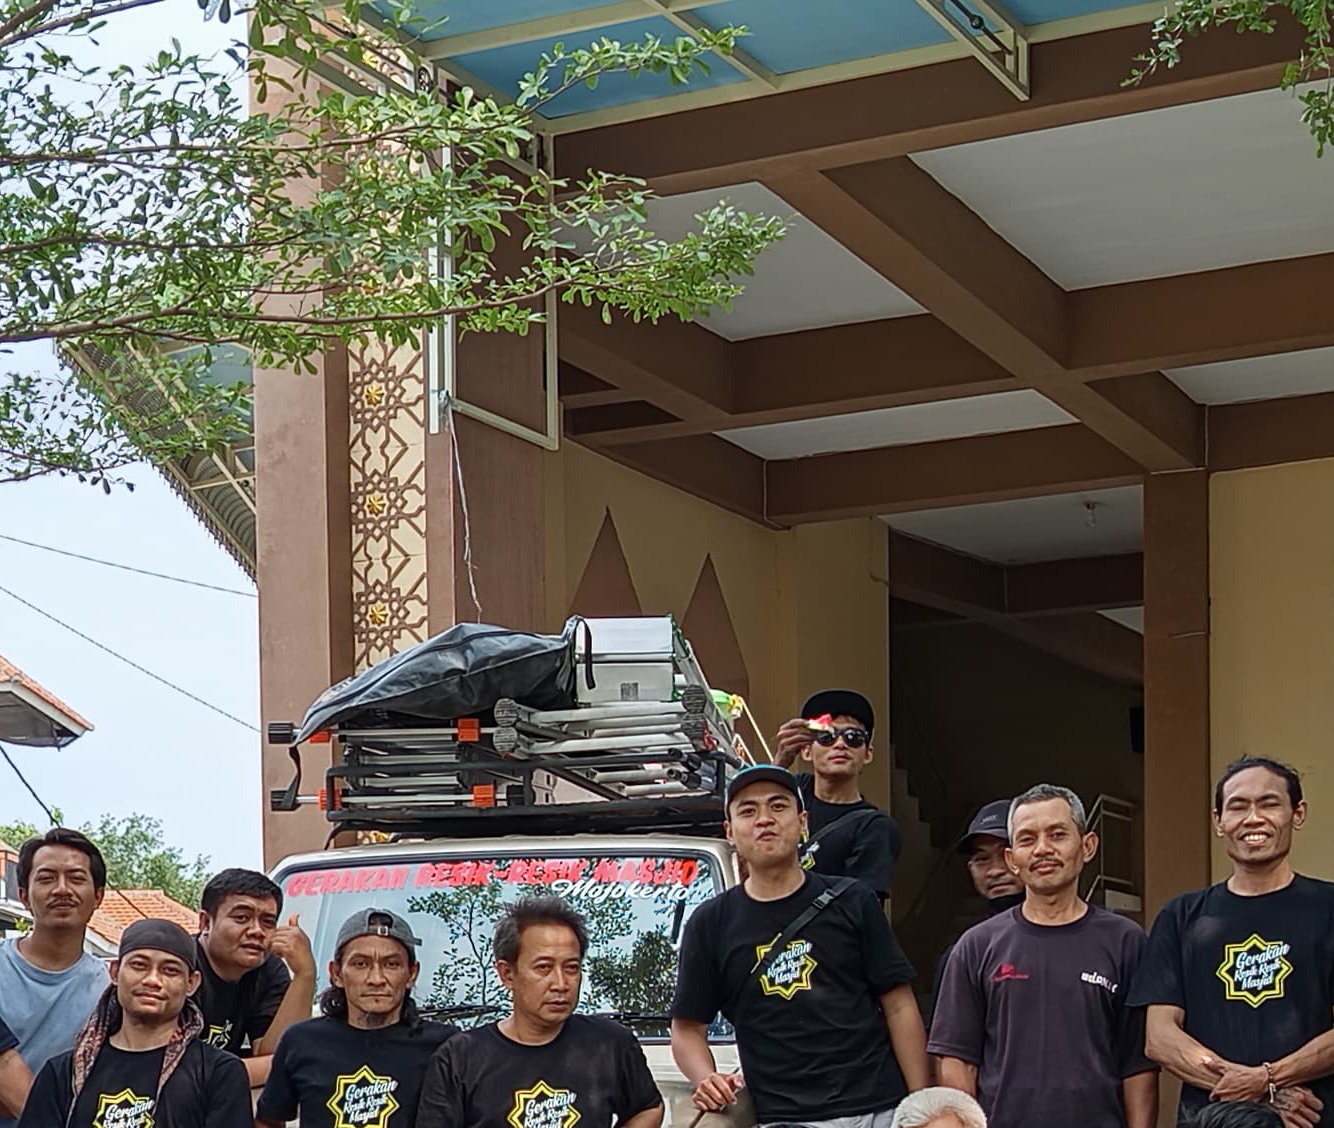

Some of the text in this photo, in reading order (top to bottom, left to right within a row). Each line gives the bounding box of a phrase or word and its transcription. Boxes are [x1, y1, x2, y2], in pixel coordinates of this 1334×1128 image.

[286, 866, 411, 897] GERAKAN
[593, 857, 699, 886] MASJID
[551, 877, 691, 904] Mojokerto
[775, 942, 812, 963] erakan
[1236, 944, 1291, 970] Gerakan
[345, 1078, 399, 1103] Gerakan
[105, 1099, 155, 1121] Gerakan
[526, 1092, 577, 1117] Gerakan
